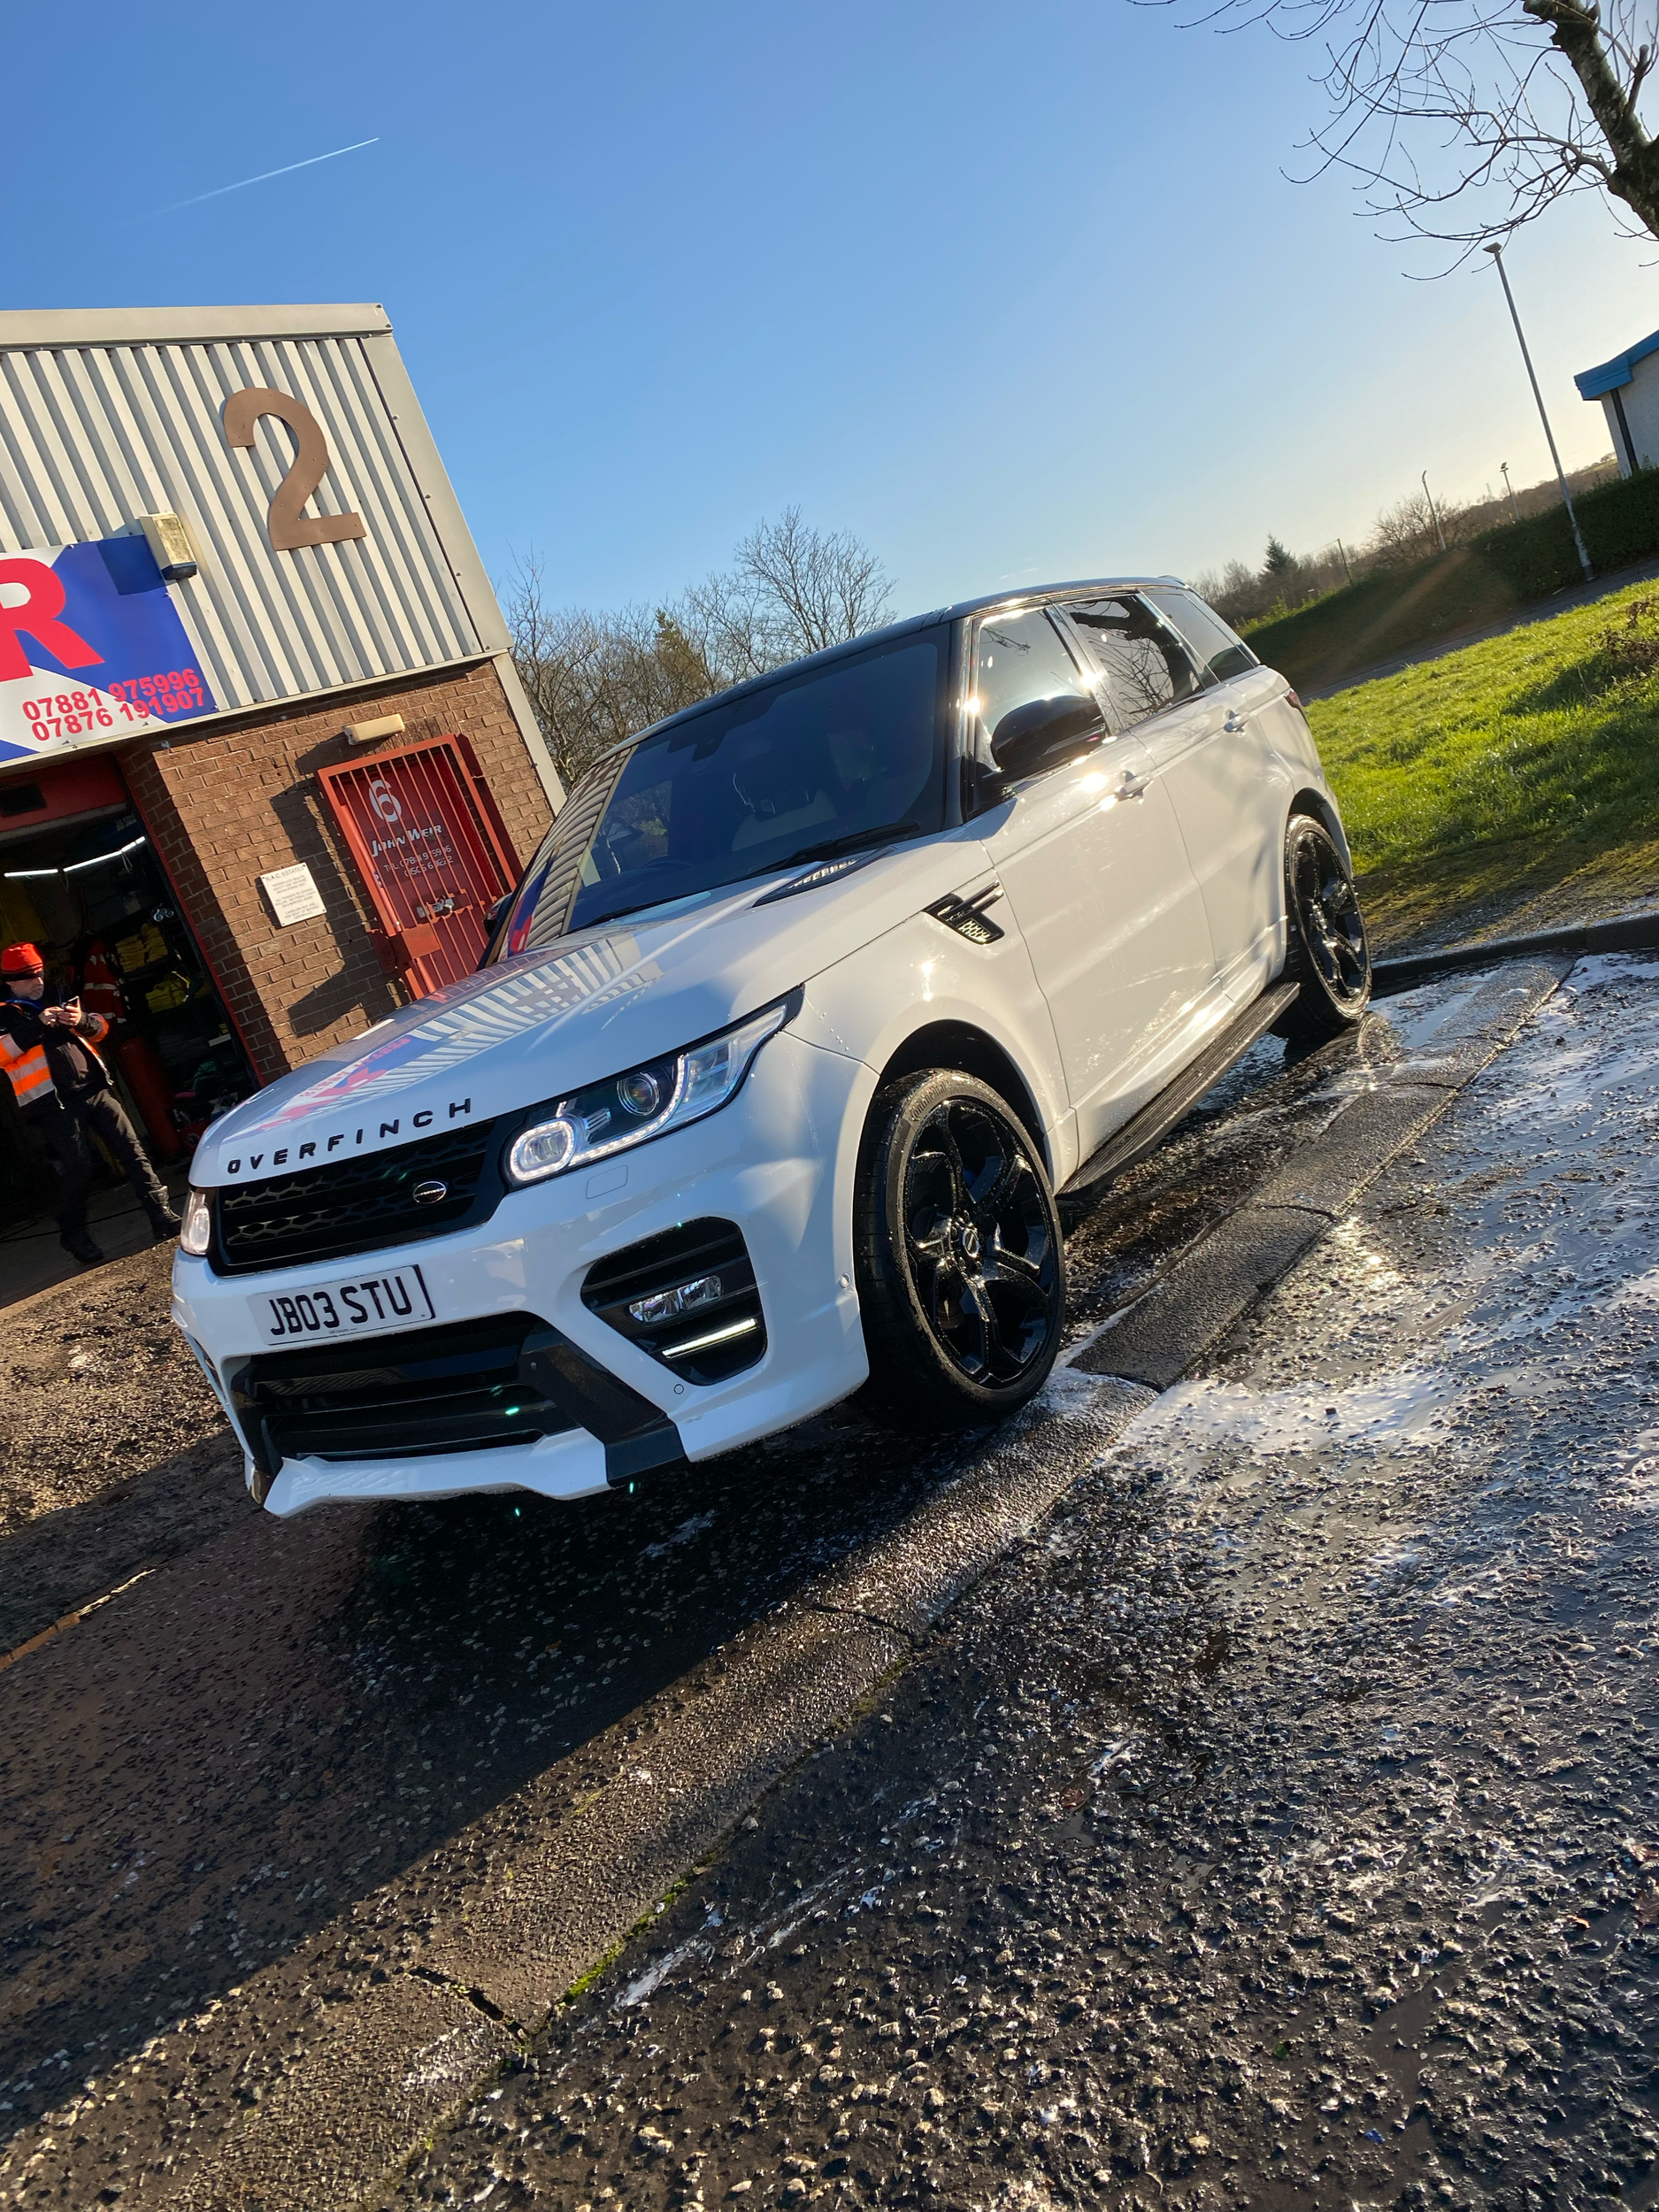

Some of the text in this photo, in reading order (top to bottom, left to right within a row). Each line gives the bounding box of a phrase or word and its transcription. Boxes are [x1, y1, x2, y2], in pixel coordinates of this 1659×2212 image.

[223, 387, 367, 551] 2
[22, 668, 200, 721] 07881 975996
[31, 687, 204, 741] 07876 191907
[368, 779, 403, 823] 6
[281, 867, 304, 876] ESTATES
[227, 1097, 472, 1174] OVERFINCH
[269, 1275, 413, 1337] JB03 STU
